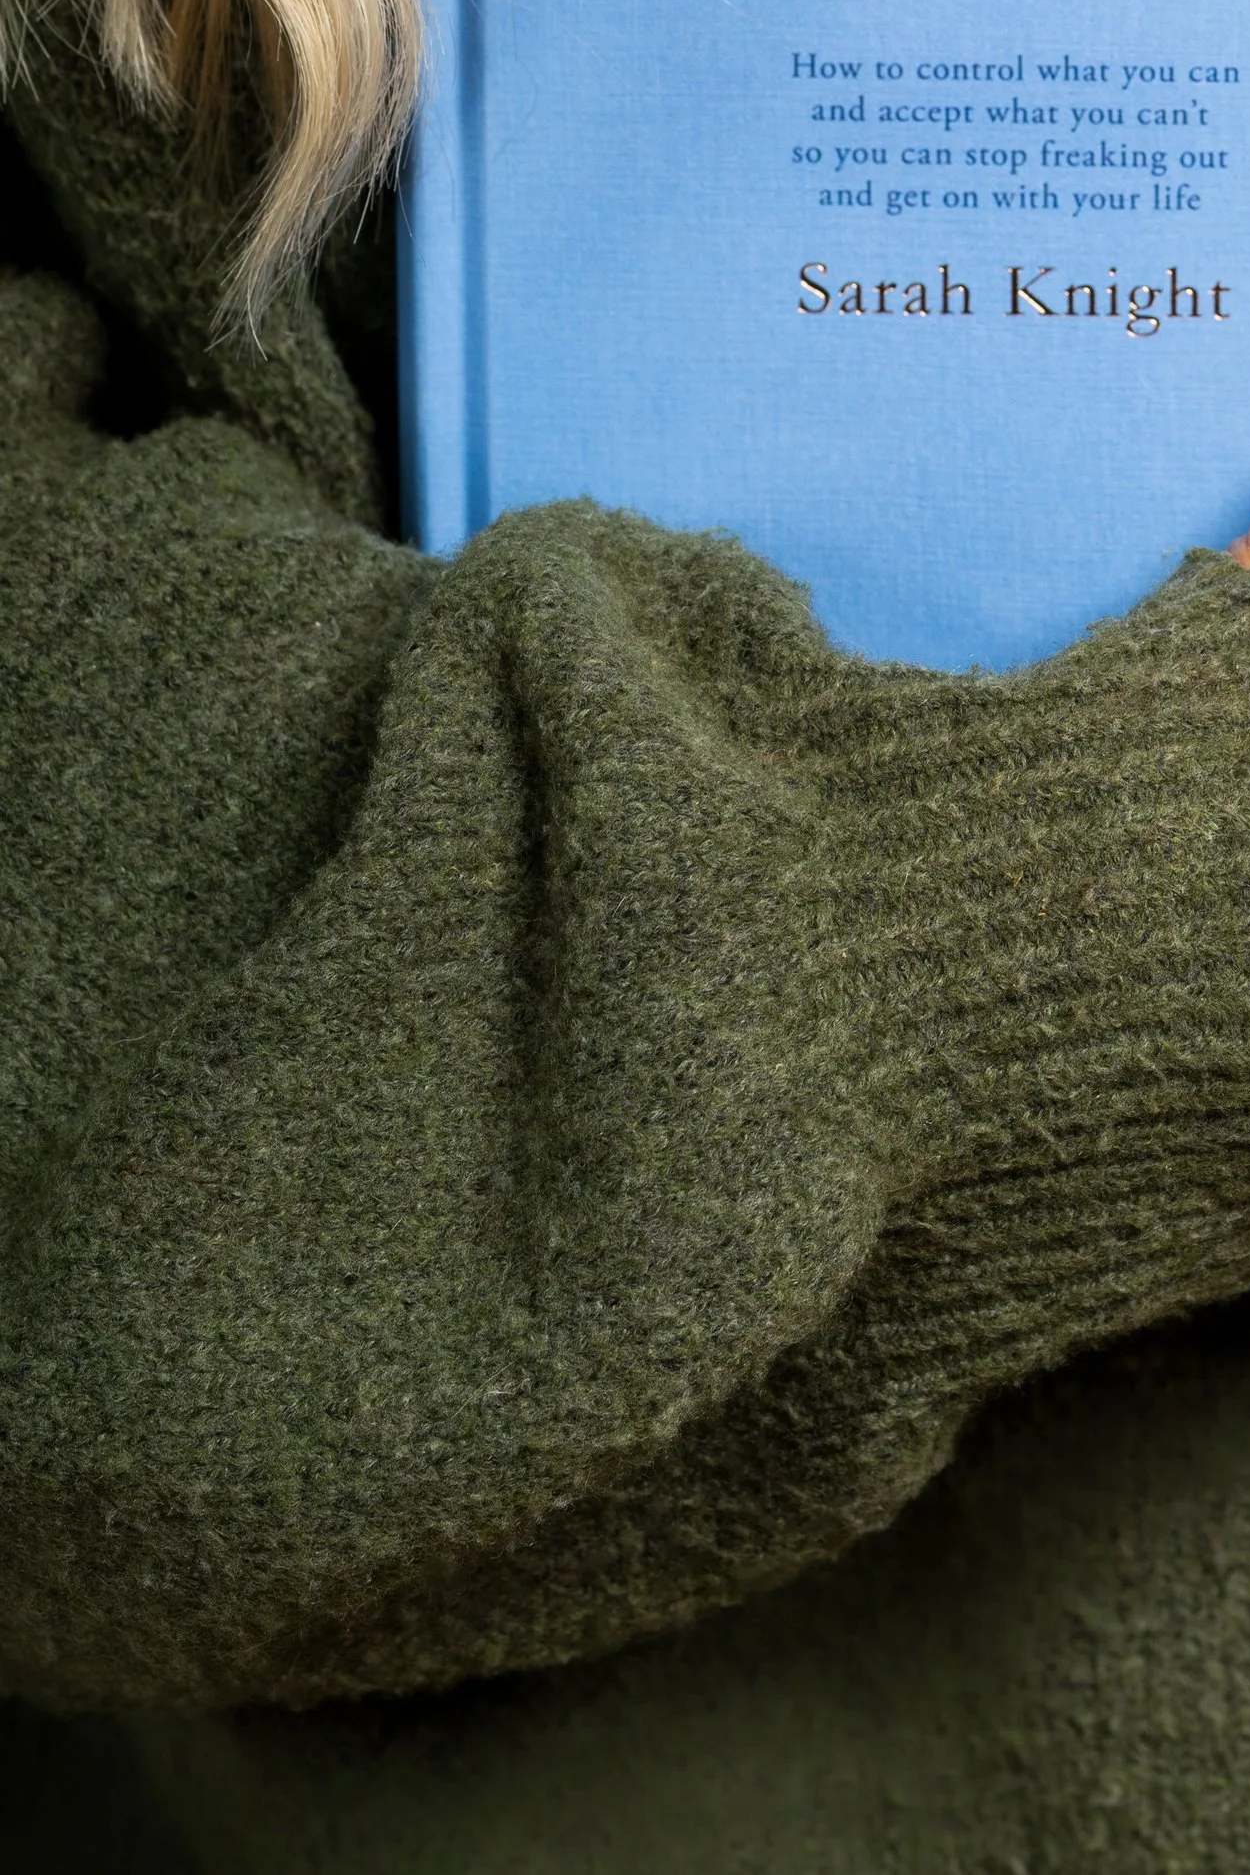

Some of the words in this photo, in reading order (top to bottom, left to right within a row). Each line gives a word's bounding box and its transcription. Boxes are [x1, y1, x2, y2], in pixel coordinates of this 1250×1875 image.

[791, 53, 862, 81] How
[875, 60, 903, 81] to
[917, 55, 1024, 83] control
[1037, 58, 1110, 83] what
[1122, 63, 1175, 89] you
[1188, 65, 1240, 84] can
[811, 95, 865, 123] and
[878, 101, 973, 131] accept
[986, 97, 1058, 125] what
[1071, 106, 1124, 132] you
[791, 145, 822, 165] so
[835, 146, 888, 172] you
[900, 147, 952, 166] can
[965, 145, 1028, 174] stop
[1040, 140, 1168, 176] freaking
[1179, 147, 1229, 170] out
[818, 180, 873, 208] and
[886, 185, 929, 215] get
[942, 189, 979, 208] on
[993, 182, 1059, 210] with
[1072, 190, 1139, 217] your
[1153, 184, 1201, 211] life
[797, 261, 973, 317] Sarah
[1004, 266, 1231, 338] Knight
